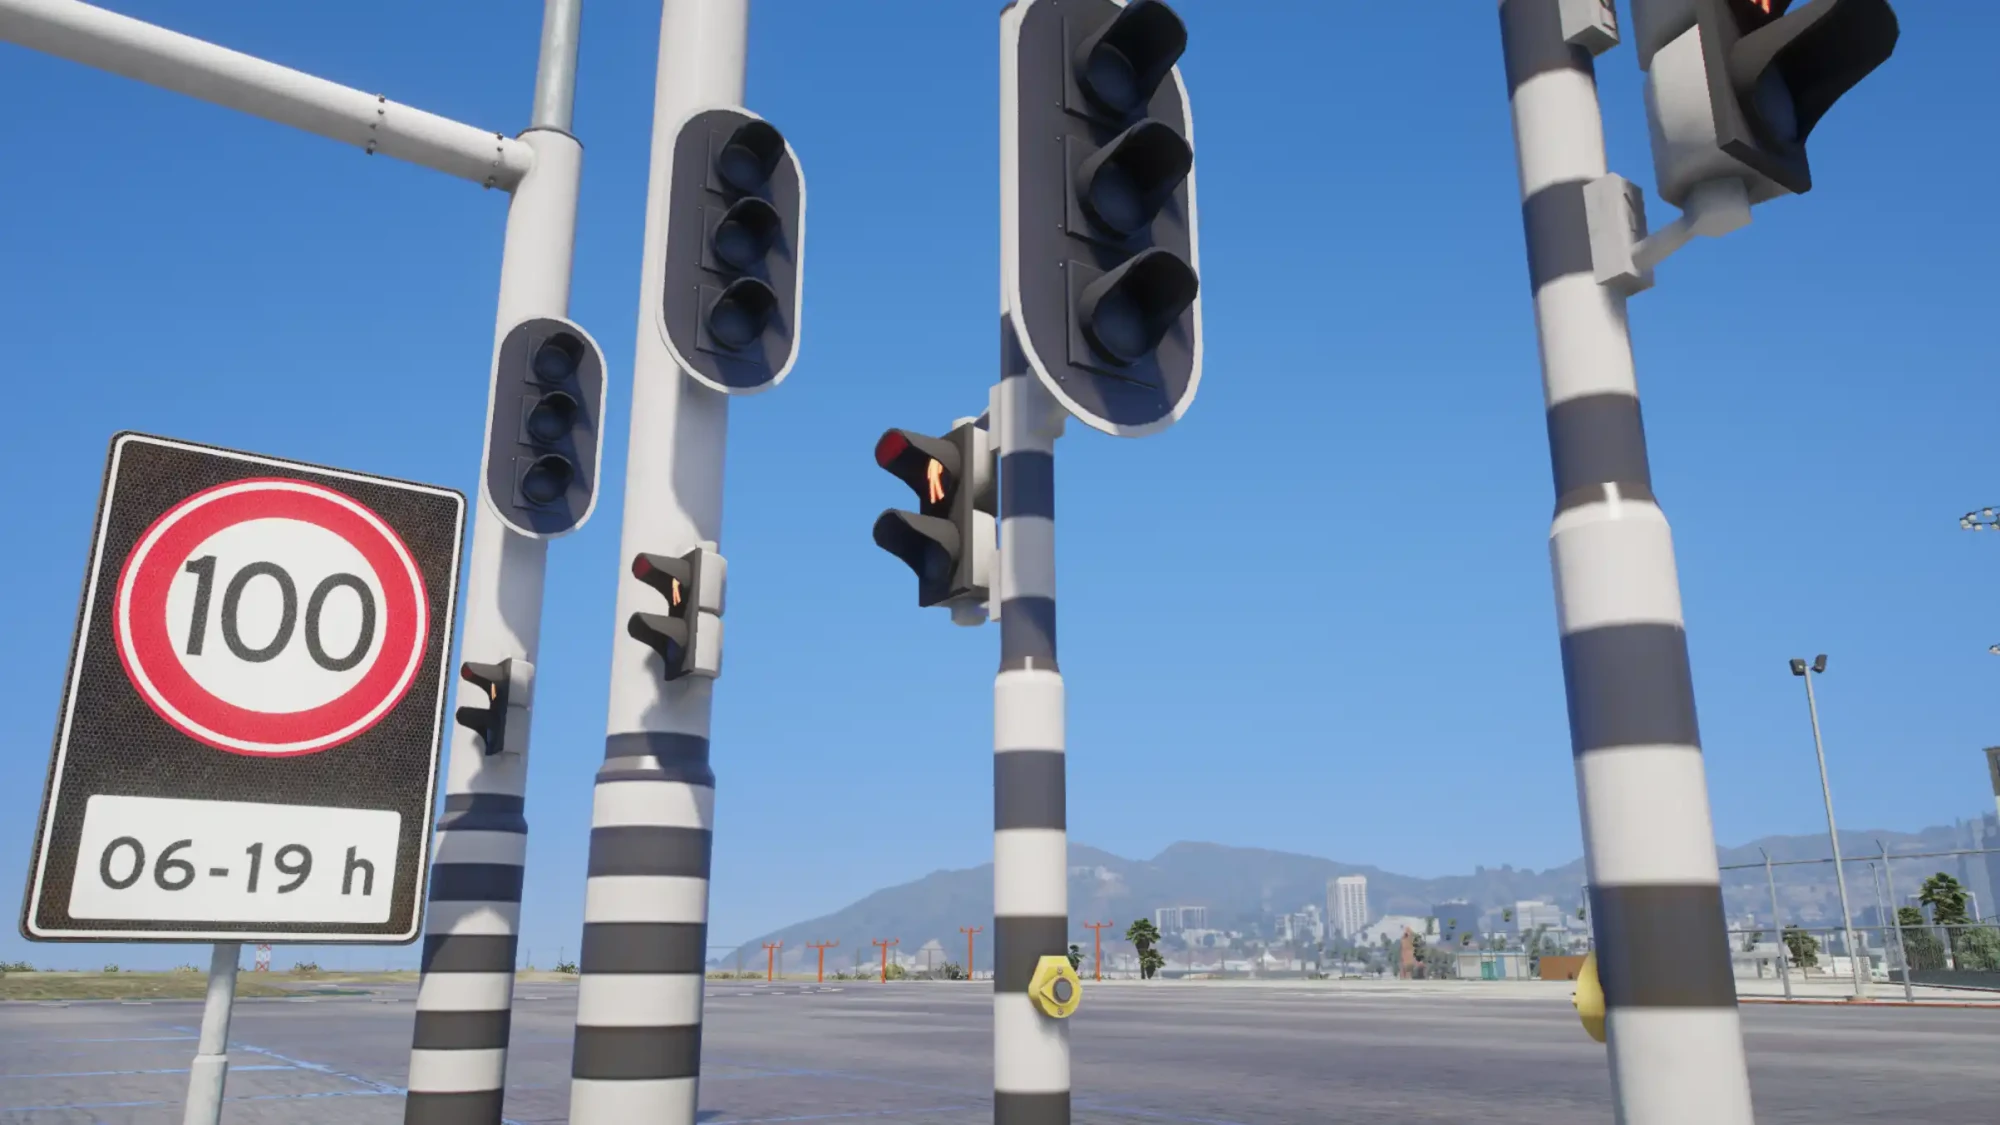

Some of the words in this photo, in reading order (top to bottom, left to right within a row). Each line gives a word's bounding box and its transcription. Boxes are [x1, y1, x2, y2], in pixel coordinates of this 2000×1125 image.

[185, 555, 376, 672] 100
[99, 836, 313, 894] 06-19
[341, 846, 375, 896] h
